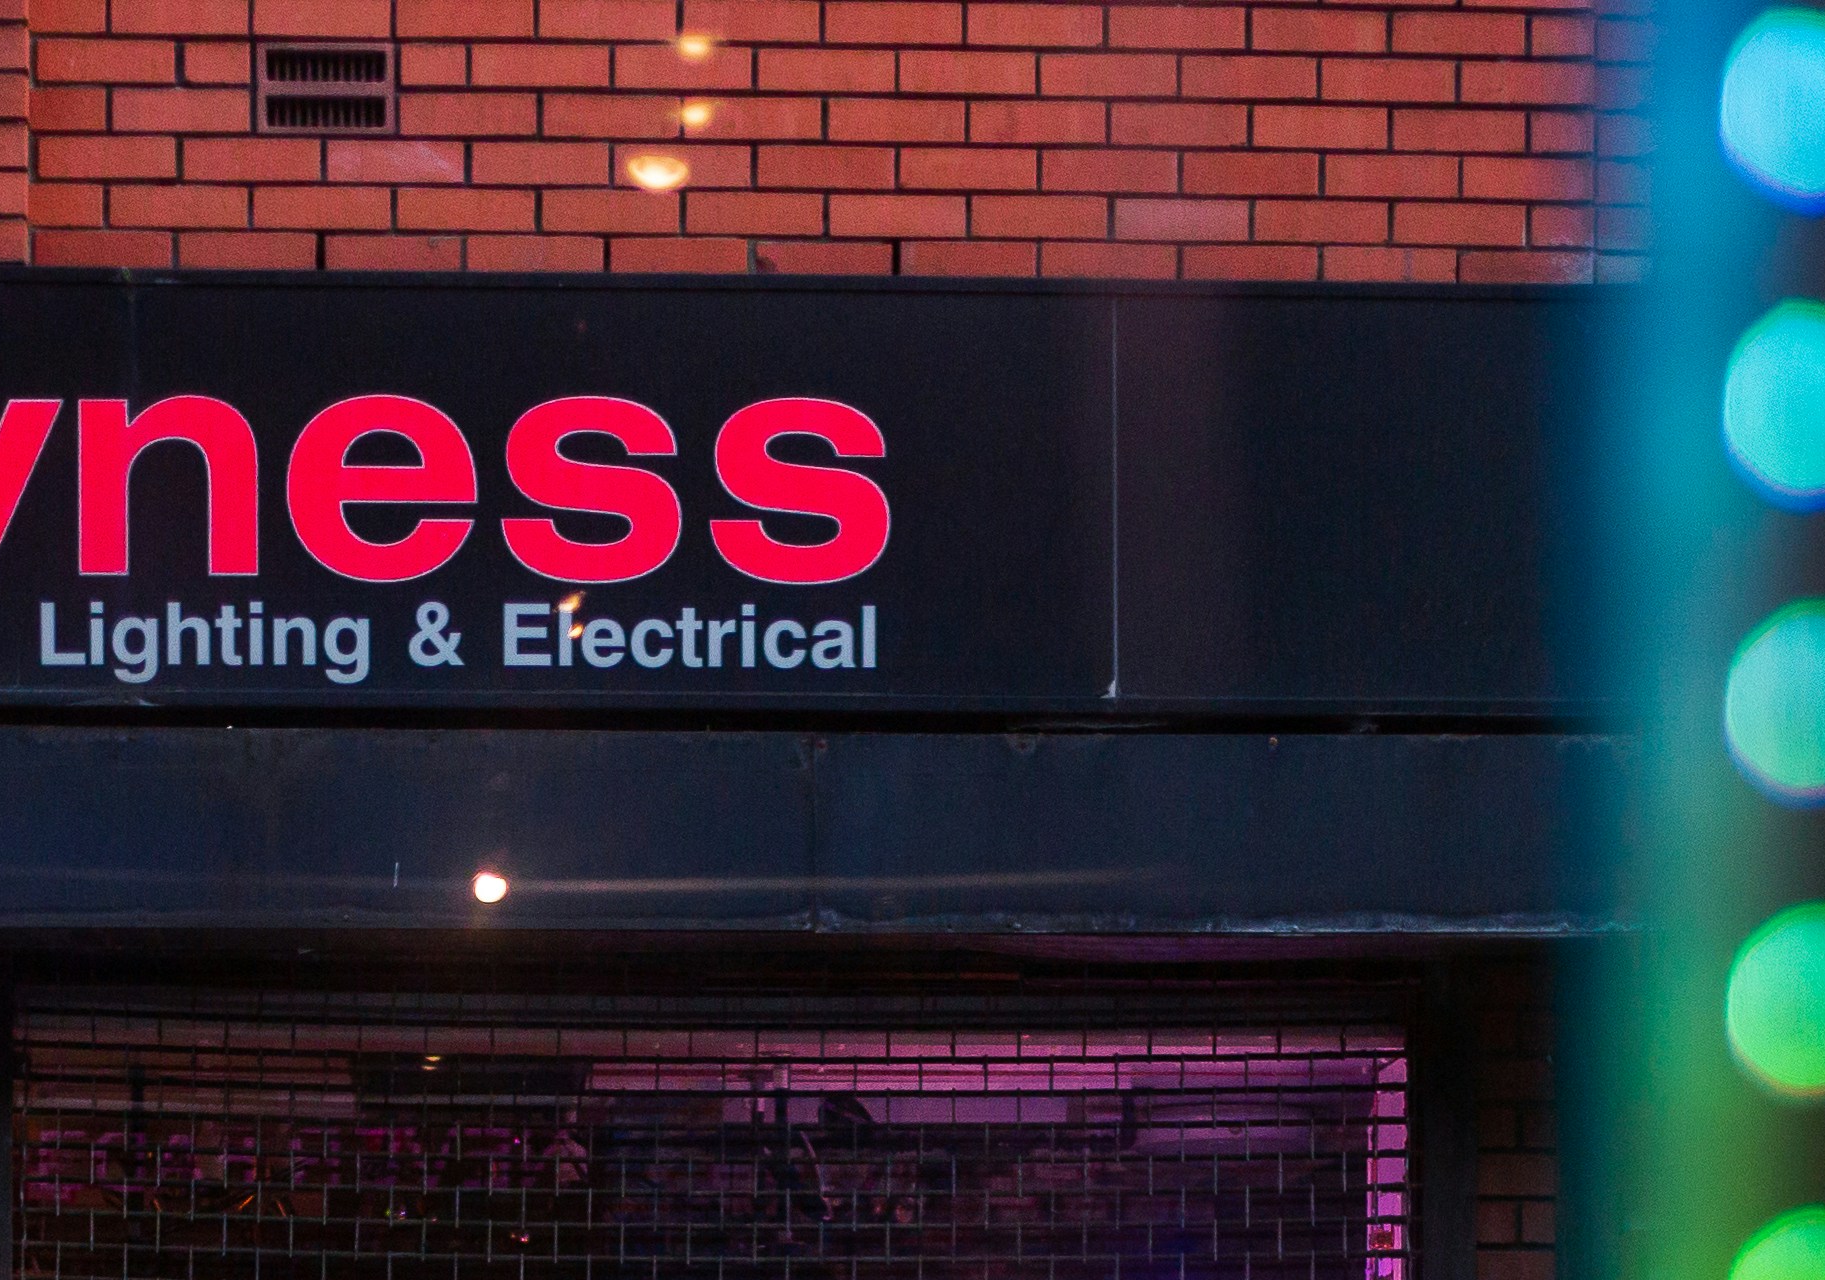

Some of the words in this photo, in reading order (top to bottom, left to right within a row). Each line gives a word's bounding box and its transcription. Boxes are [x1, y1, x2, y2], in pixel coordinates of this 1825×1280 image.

[39, 601, 370, 684] Lighting
[407, 600, 464, 668] &
[503, 600, 877, 669] Electrical
